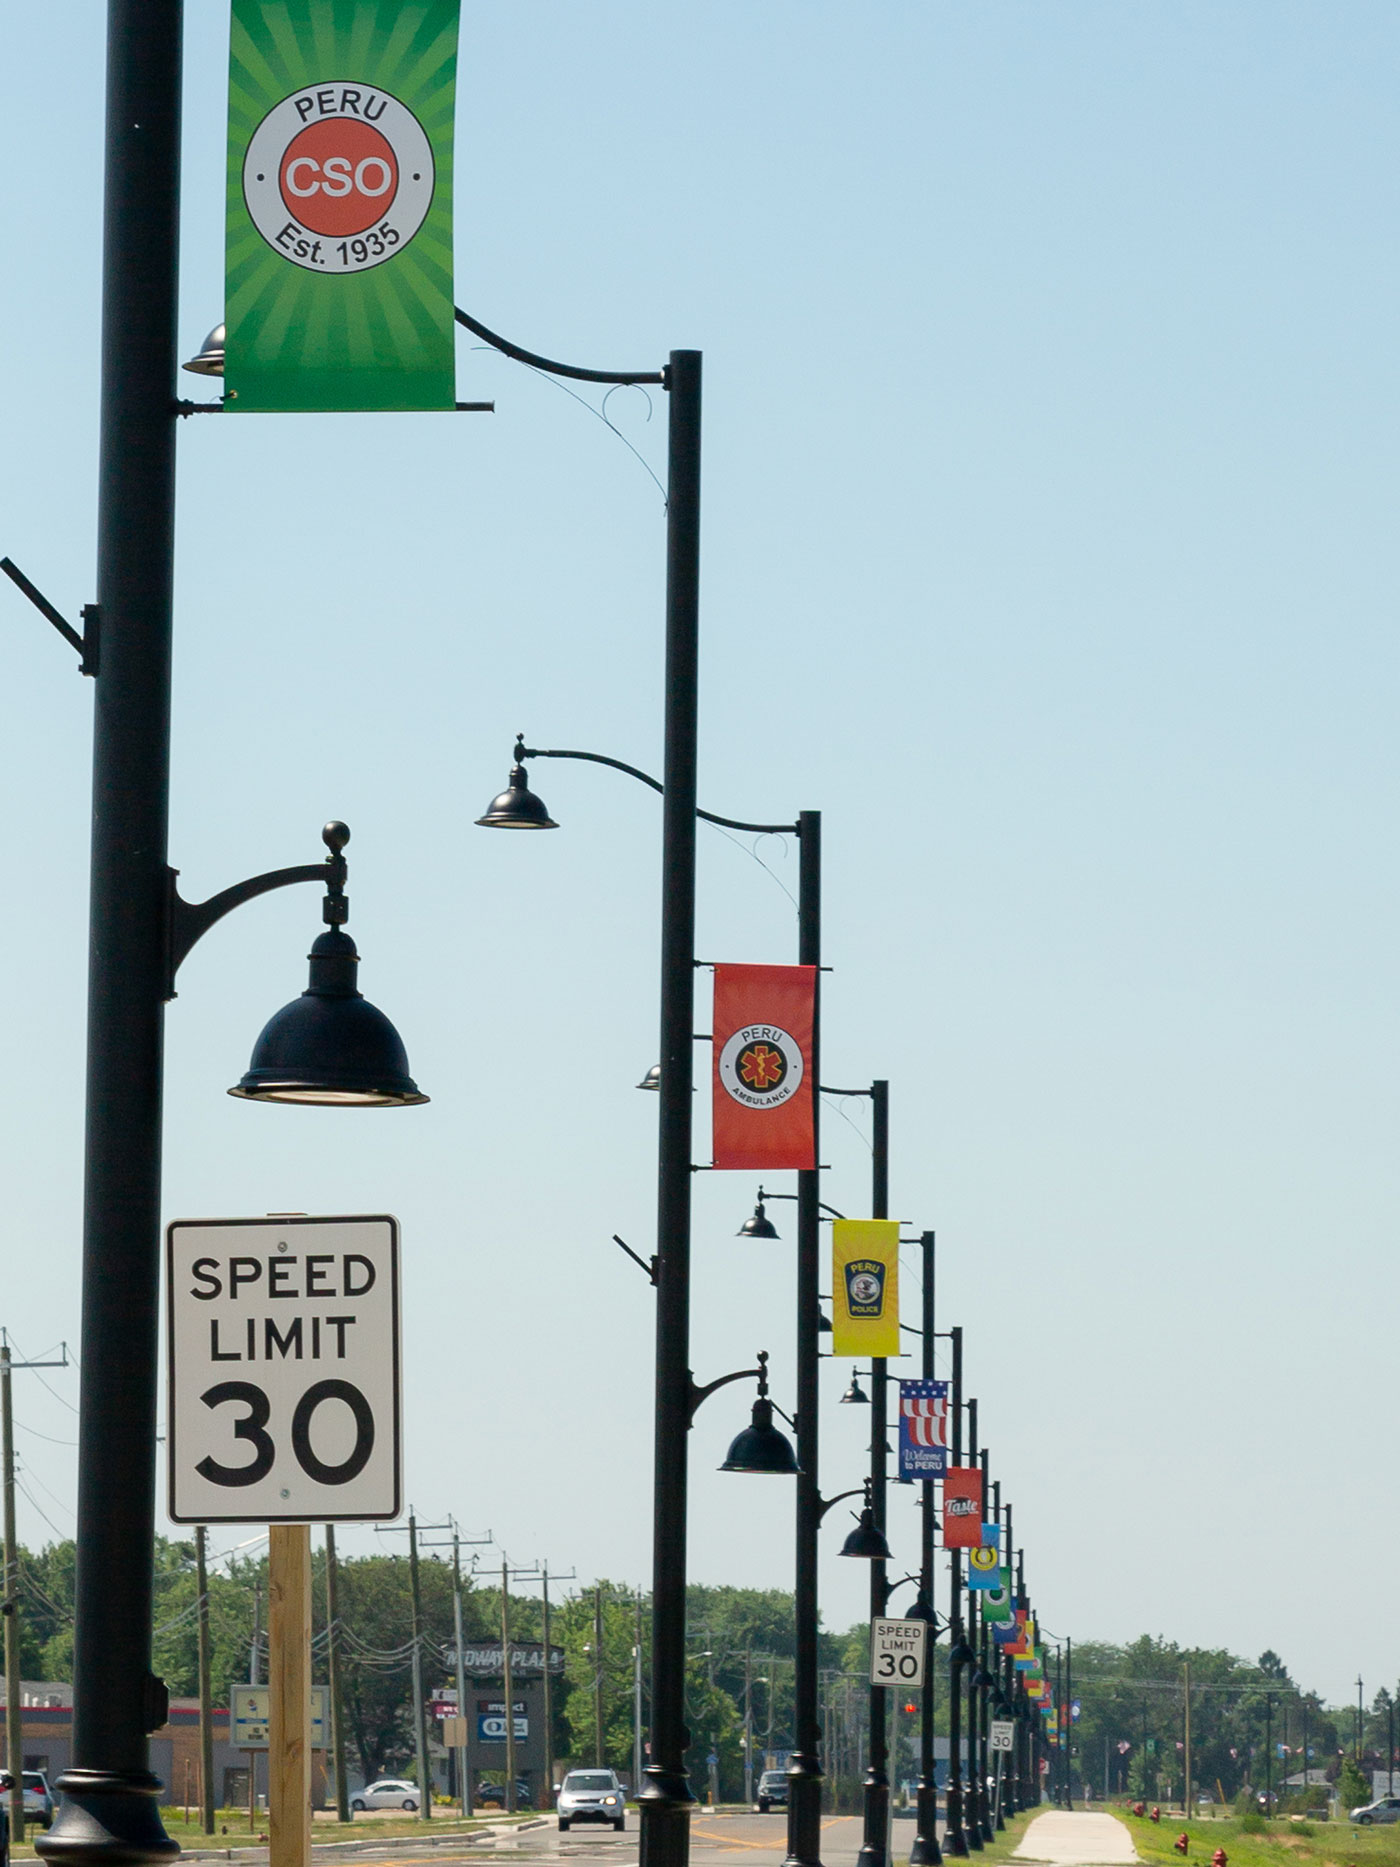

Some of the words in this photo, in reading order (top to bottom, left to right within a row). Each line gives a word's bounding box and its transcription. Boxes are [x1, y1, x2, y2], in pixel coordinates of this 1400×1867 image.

[294, 89, 388, 122] PERU
[286, 157, 392, 197] CSO
[275, 222, 325, 265] Est.
[336, 222, 400, 265] 1935
[741, 1027, 783, 1042] PERU
[732, 1087, 791, 1105] AMBULANCE
[850, 1262, 880, 1273] PERU
[190, 1254, 376, 1300] SPEED
[851, 1305, 878, 1313] POLICE
[211, 1316, 356, 1361] LIMIT
[194, 1379, 375, 1487] 30
[904, 1449, 941, 1461] Welcome
[904, 1461, 914, 1470] to
[915, 1461, 943, 1470] PERU
[945, 1499, 977, 1513] Taste
[878, 1626, 921, 1638] SPEED
[882, 1640, 915, 1651] LIMIT
[446, 1650, 505, 1666] MDWAY
[878, 1653, 918, 1679] 30
[992, 1735, 1011, 1747] 30
